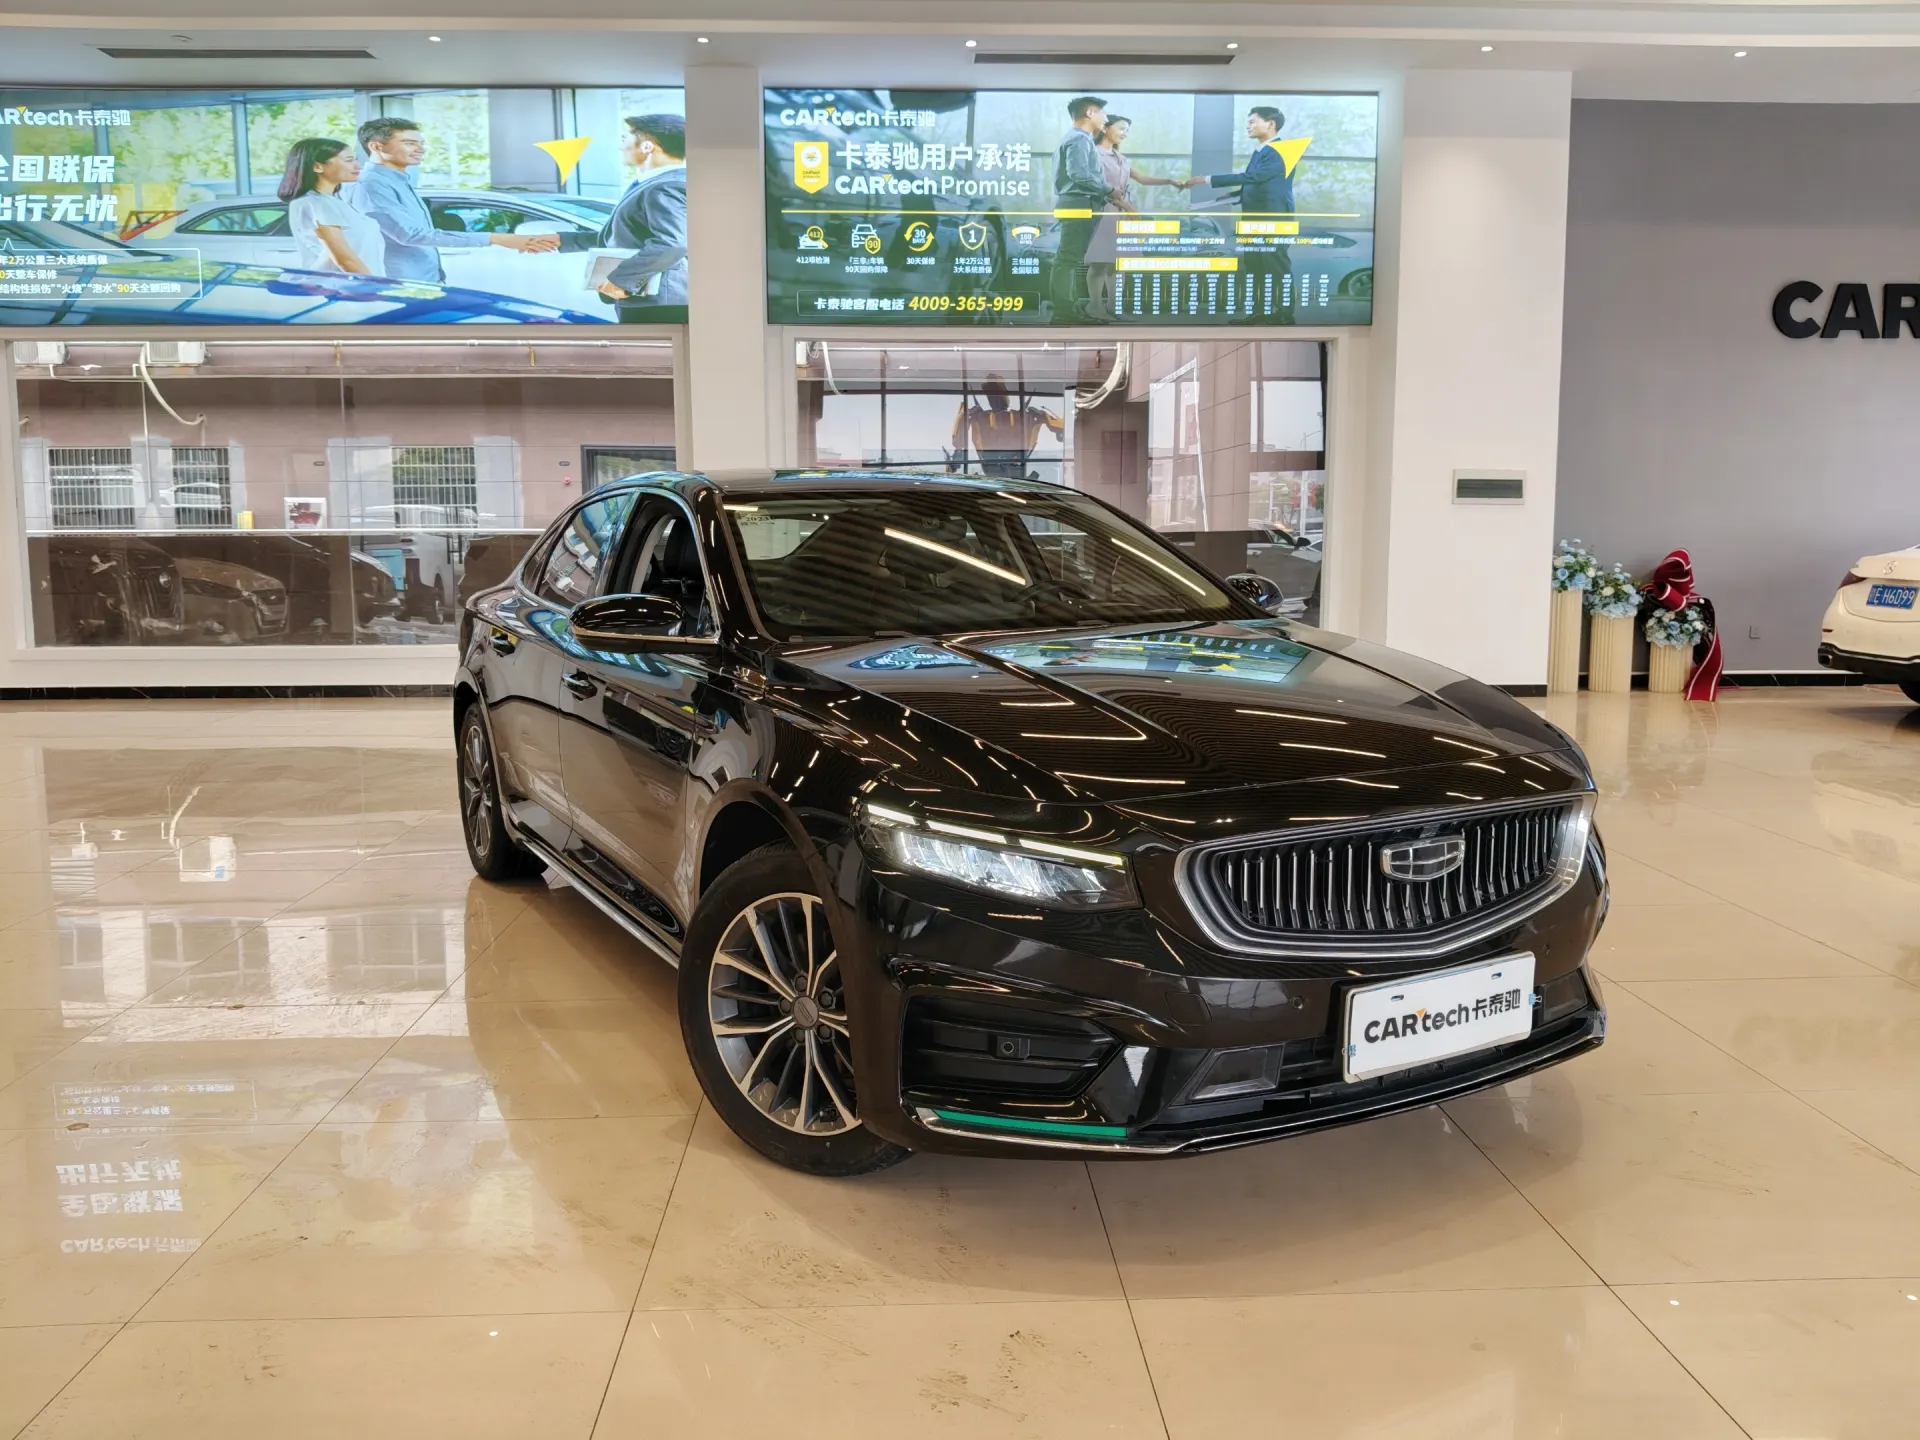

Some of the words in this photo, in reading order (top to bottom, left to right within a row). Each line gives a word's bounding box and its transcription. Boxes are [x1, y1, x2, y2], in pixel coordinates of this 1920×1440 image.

[0, 107, 73, 126] Rtech
[74, 109, 131, 126] 卡泰驰
[780, 109, 879, 127] CARtech
[881, 110, 936, 127] 卡泰驰
[836, 141, 1032, 172] 卡泰驰用户承诺
[835, 174, 937, 195] CARtech
[941, 175, 1031, 196] Promise
[914, 229, 926, 238] 30
[968, 229, 977, 243] 1
[868, 240, 879, 249] 90
[814, 298, 905, 311] 卡泰驰客服电话
[908, 296, 1024, 312] 4009-365-999
[1772, 280, 1920, 339] CAR
[1364, 1003, 1470, 1044] CARtech
[1471, 988, 1522, 1020] 卡泰驰
